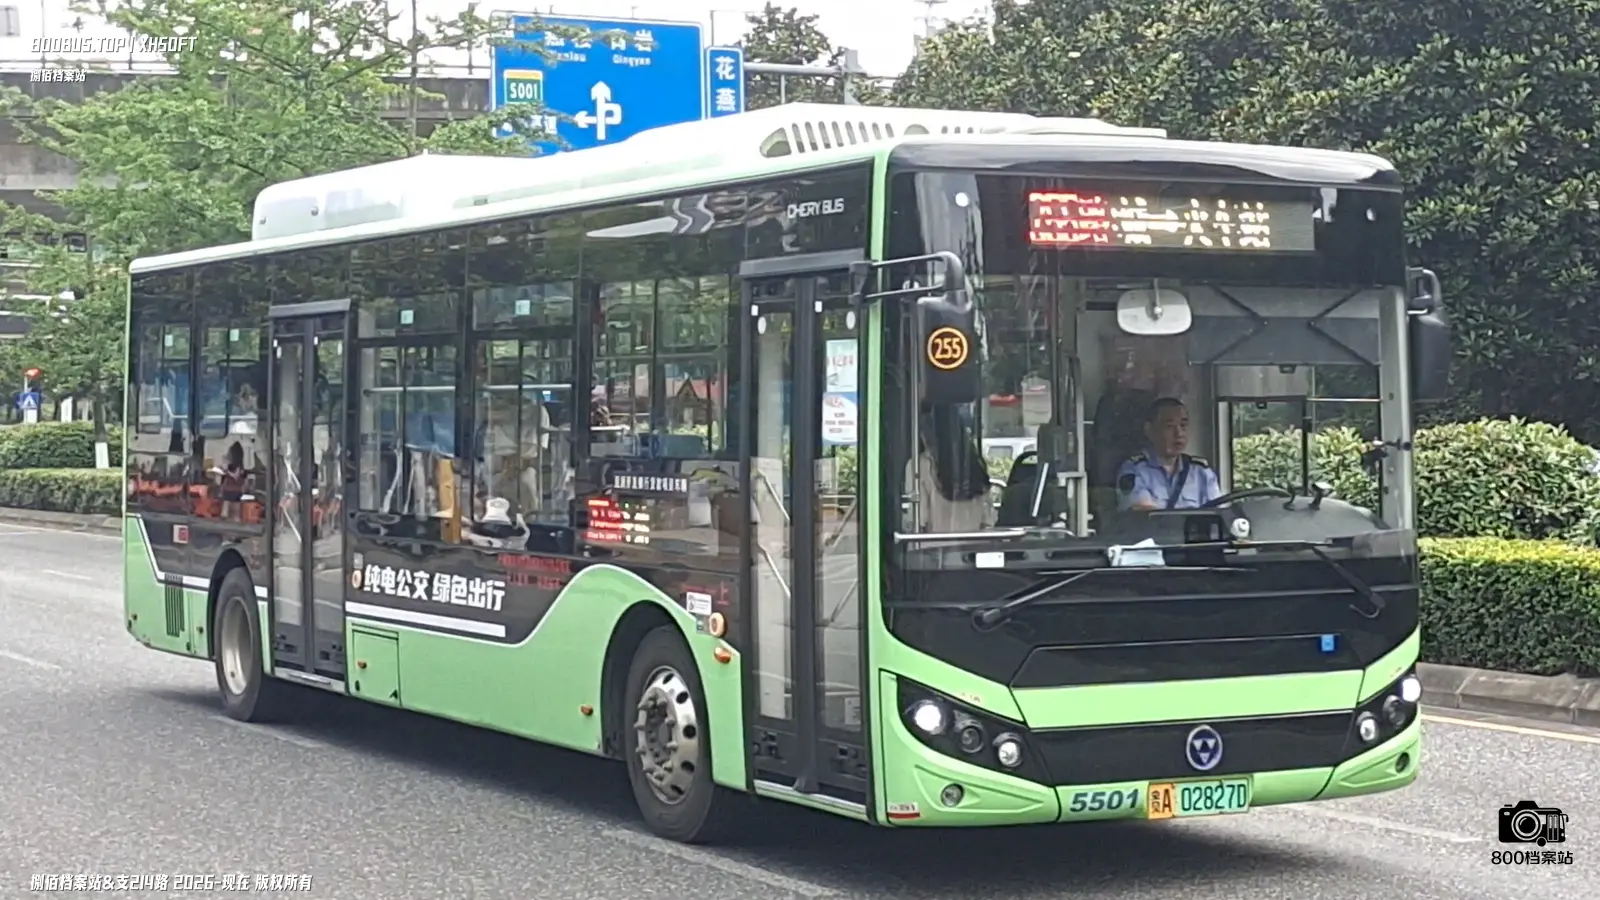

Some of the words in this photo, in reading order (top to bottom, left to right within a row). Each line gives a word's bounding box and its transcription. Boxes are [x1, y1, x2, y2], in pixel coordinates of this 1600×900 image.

[509, 83, 538, 99] S001
[787, 201, 821, 219] CHERY
[822, 197, 845, 215] BUS
[934, 338, 961, 360] 255
[363, 564, 430, 601] 纯电公交
[432, 572, 506, 611] 绿色出行
[1069, 788, 1140, 813] 5501
[1181, 784, 1247, 812] 02827D
